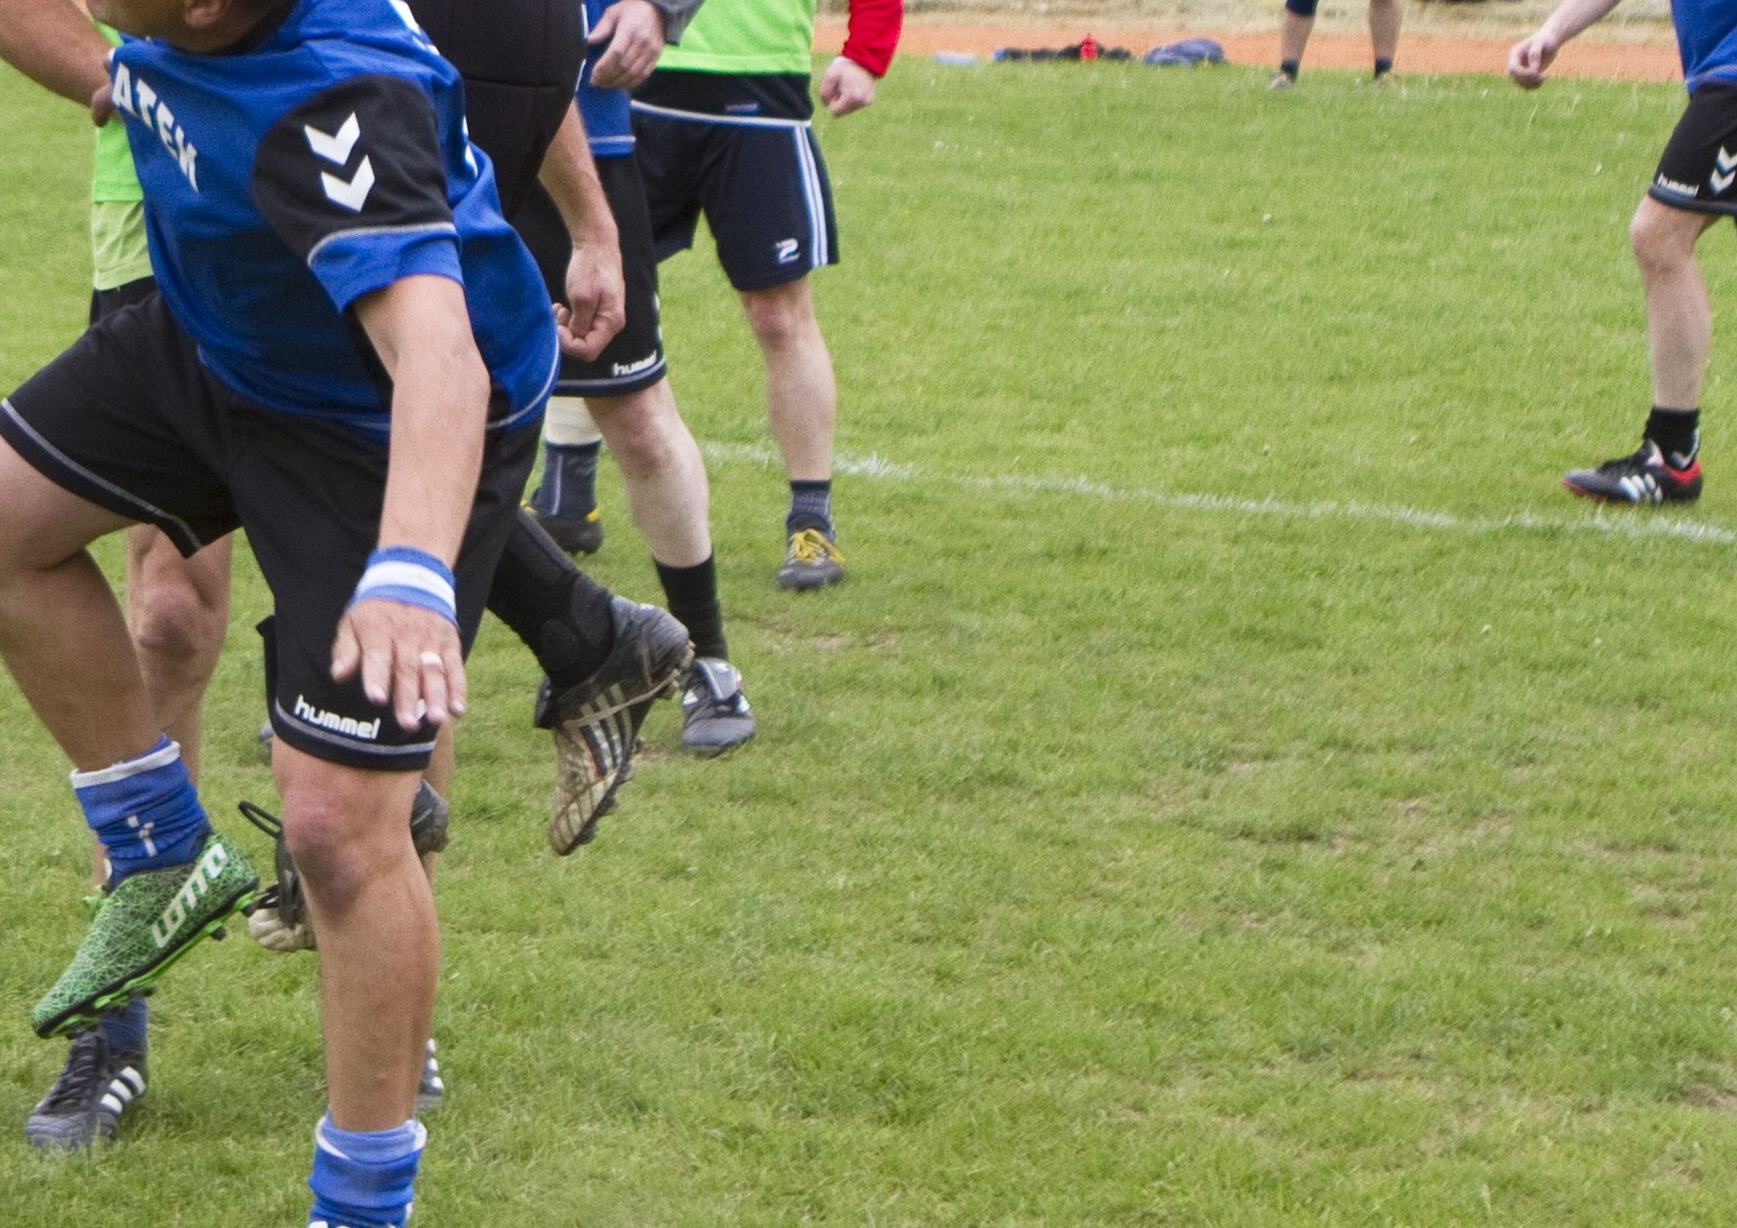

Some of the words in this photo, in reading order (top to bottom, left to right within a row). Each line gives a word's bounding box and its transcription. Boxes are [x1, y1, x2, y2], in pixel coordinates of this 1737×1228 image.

[110, 58, 200, 194] ATEK
[294, 693, 381, 739] hummel
[151, 842, 229, 949] LOTTO
